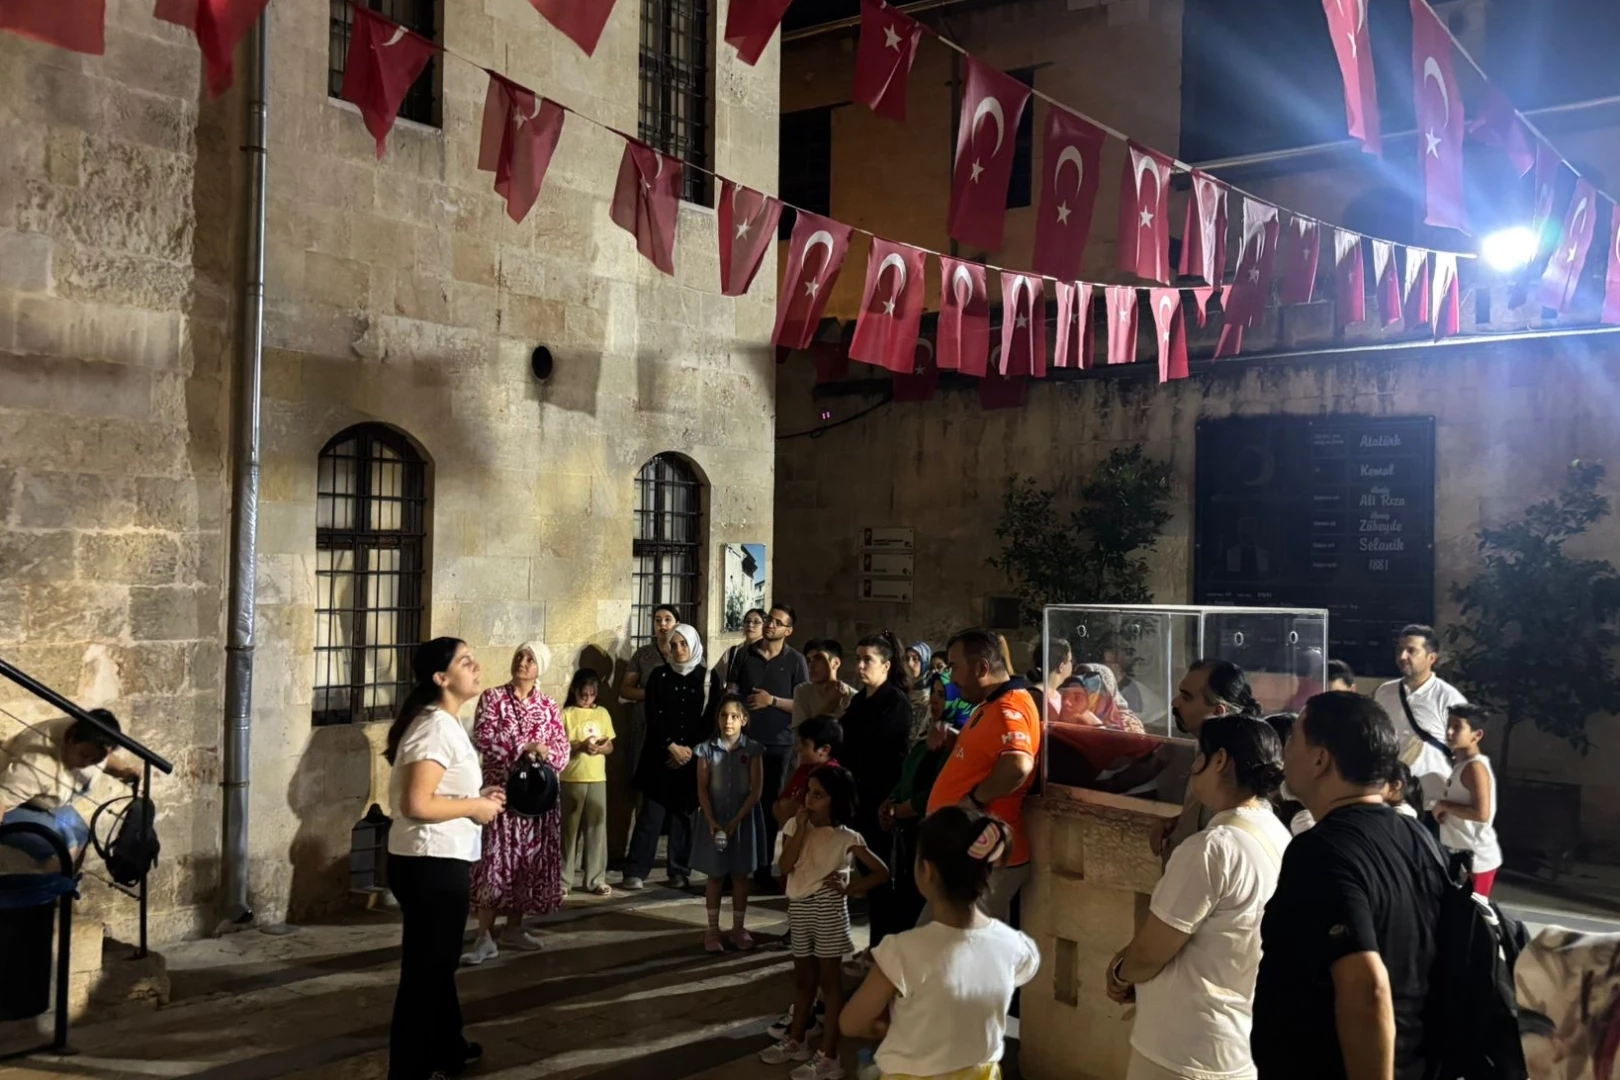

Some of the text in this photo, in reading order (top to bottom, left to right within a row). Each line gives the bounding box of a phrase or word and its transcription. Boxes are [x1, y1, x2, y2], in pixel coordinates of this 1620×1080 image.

[1359, 433, 1403, 447] Atatürk
[1360, 463, 1395, 477] Kemal
[1359, 494, 1376, 507] Ali
[1359, 519, 1403, 535] Zübeyde
[1359, 537, 1404, 551] Selanik
[1369, 558, 1389, 571] 1881
